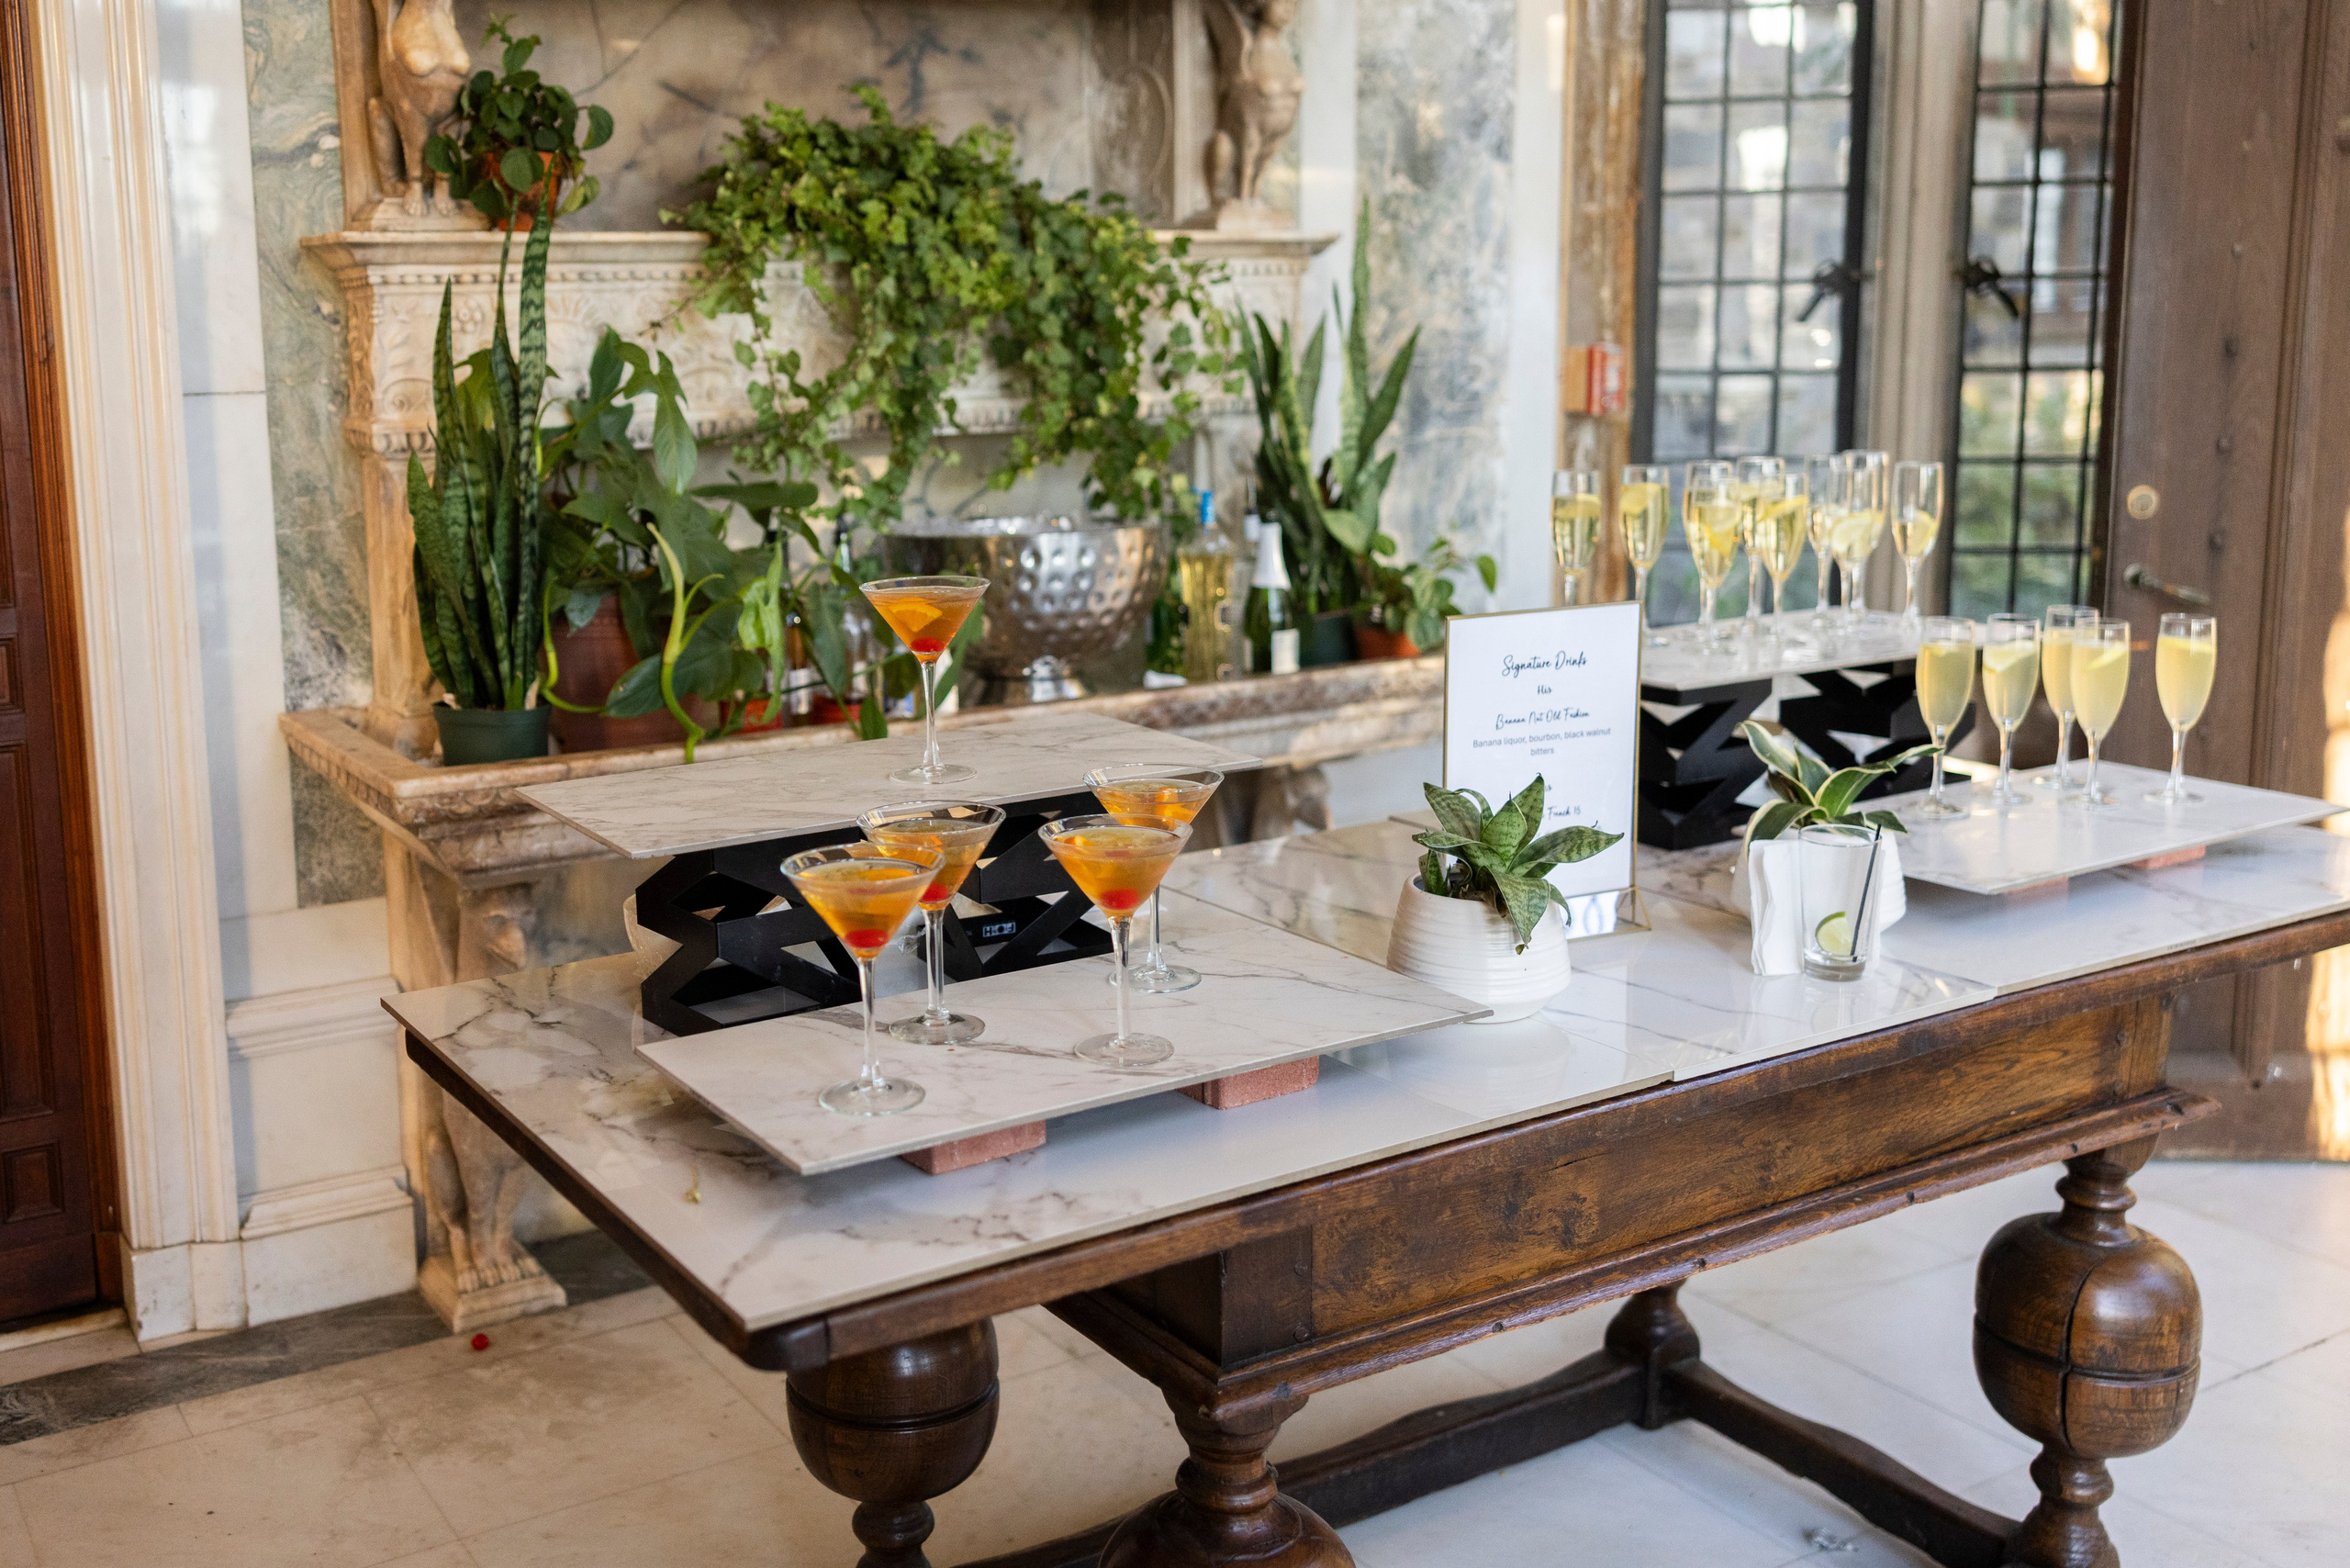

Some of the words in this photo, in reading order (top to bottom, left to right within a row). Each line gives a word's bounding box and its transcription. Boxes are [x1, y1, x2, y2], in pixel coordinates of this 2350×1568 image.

[1502, 655, 1551, 678] Signature
[1555, 650, 1587, 670] Drinks
[1537, 685, 1552, 695] His
[1495, 713, 1526, 731] Banana
[1546, 709, 1561, 722] Old
[1472, 738, 1503, 748] Banana
[1503, 735, 1528, 746] liquor,
[1528, 733, 1563, 744] bourbon,
[1564, 730, 1584, 739] black
[1585, 727, 1612, 737] walnut
[1530, 746, 1555, 756] bitters
